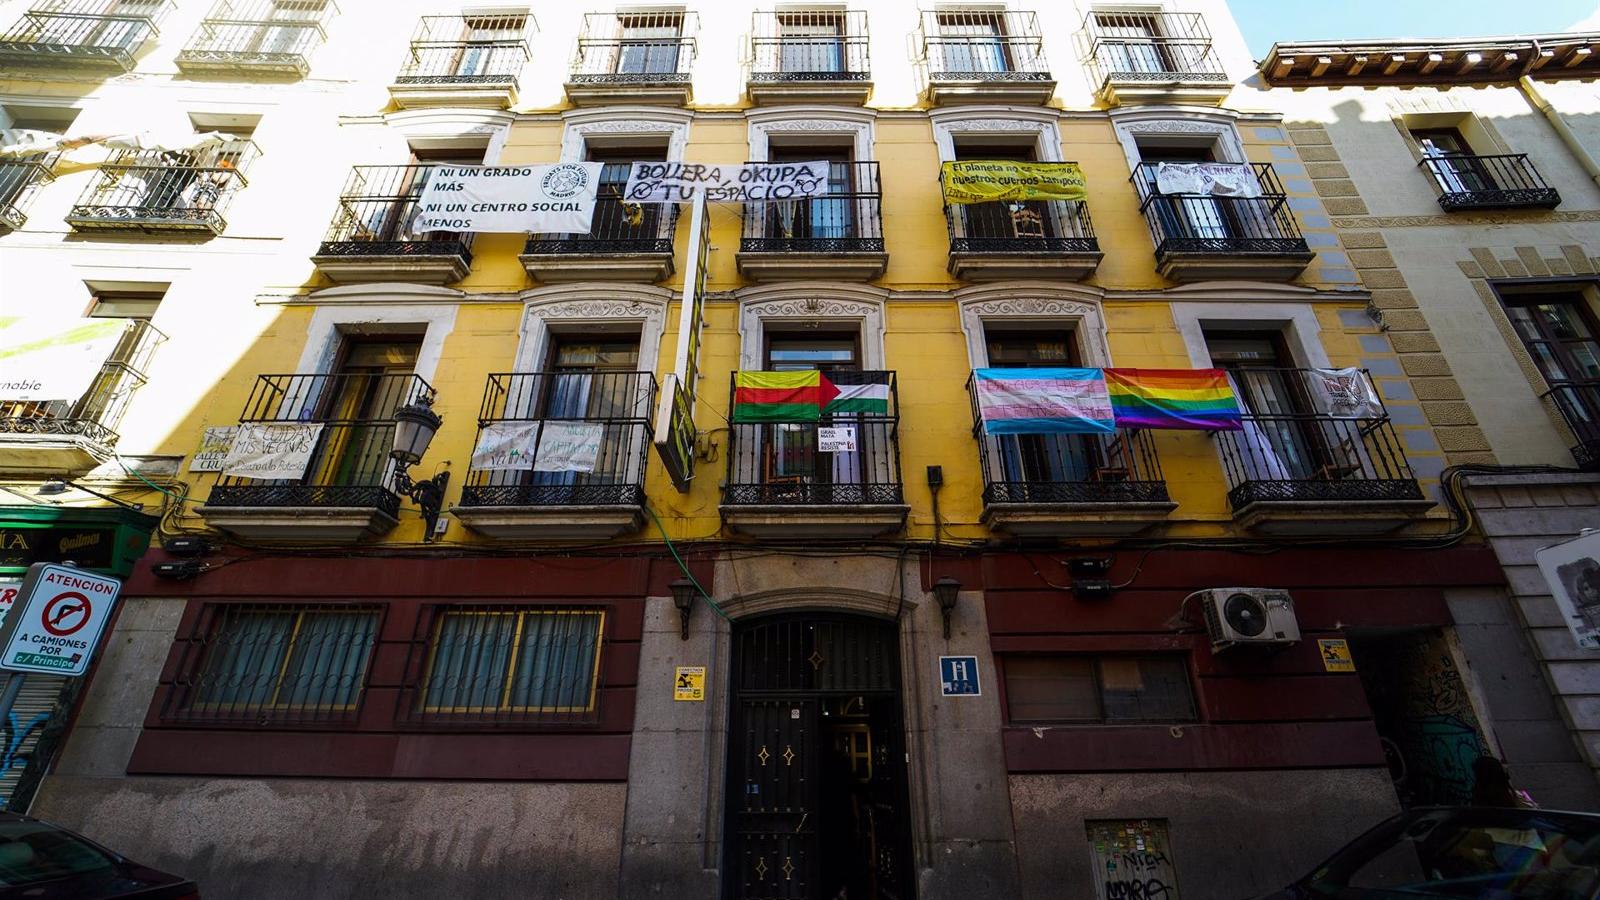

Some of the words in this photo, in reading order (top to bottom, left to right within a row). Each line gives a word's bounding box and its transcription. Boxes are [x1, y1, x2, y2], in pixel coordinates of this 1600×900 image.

[439, 169, 454, 177] NI
[458, 169, 480, 177] UN
[483, 168, 532, 177] GRADO
[738, 165, 815, 184] OKUPA
[952, 163, 963, 172] El
[965, 163, 1004, 173] planeta
[1006, 165, 1019, 173] no
[434, 181, 464, 192] MÁS
[660, 185, 694, 200] TU
[704, 184, 795, 201] ESPACIO
[425, 203, 442, 212] NI
[446, 203, 467, 212] UN
[471, 203, 527, 212] CENTRO
[531, 202, 582, 212] SOCIAL
[263, 424, 316, 441] CUIDAN
[262, 440, 310, 454] VECINAS
[46, 573, 114, 595] ATENCIÓN
[20, 633, 28, 641] A
[31, 635, 88, 649] CAMIONES
[39, 645, 62, 655] POR
